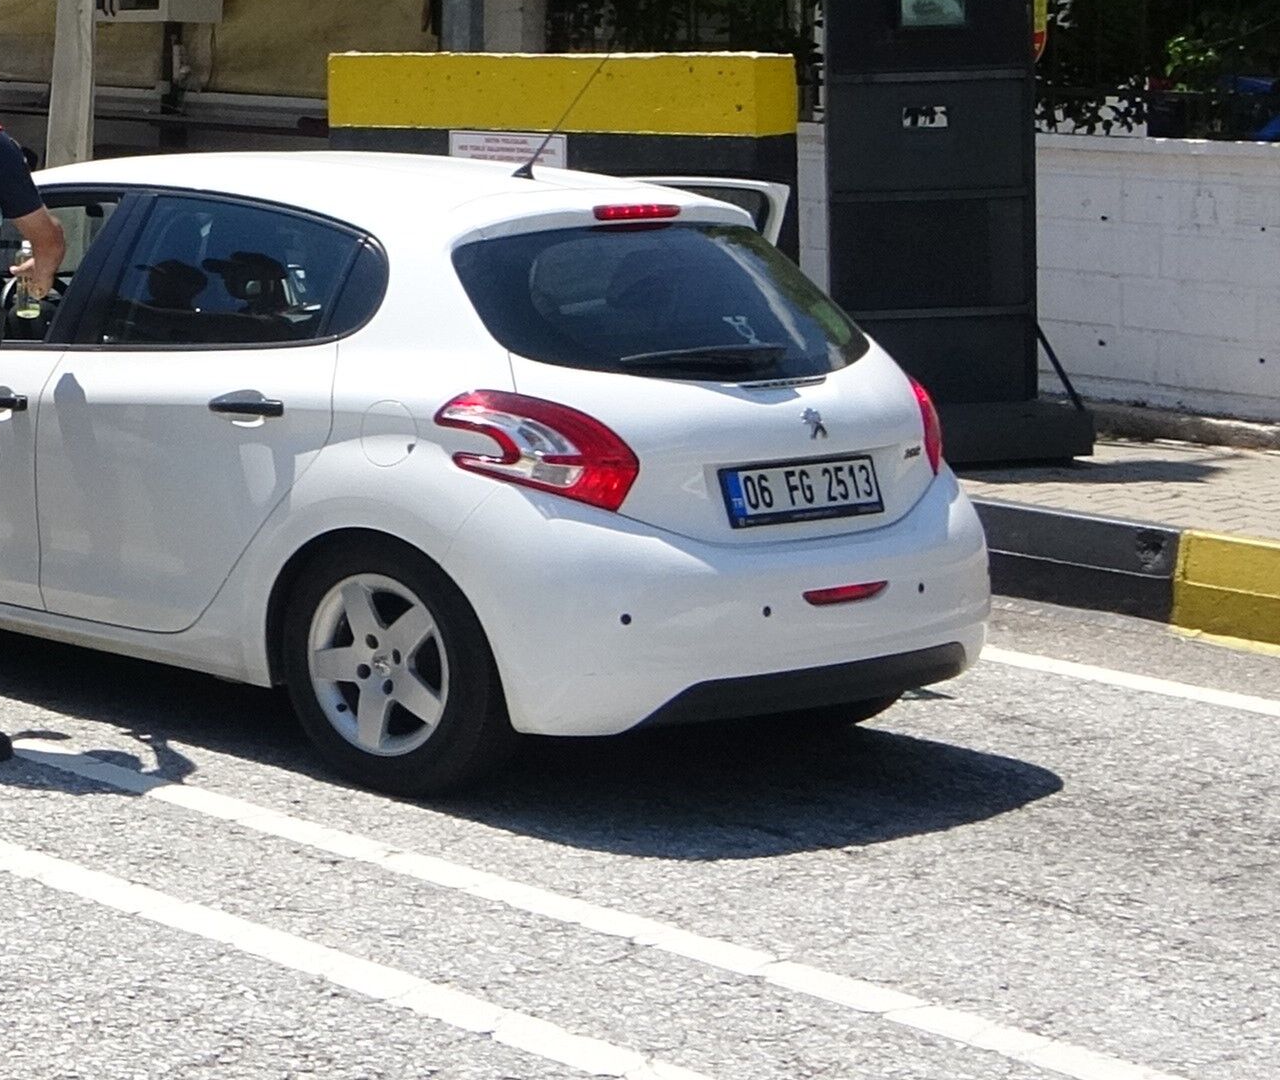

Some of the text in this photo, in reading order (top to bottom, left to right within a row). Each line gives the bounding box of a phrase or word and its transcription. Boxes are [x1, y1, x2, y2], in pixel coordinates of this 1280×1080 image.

[743, 464, 873, 510] 06 FG 2513
